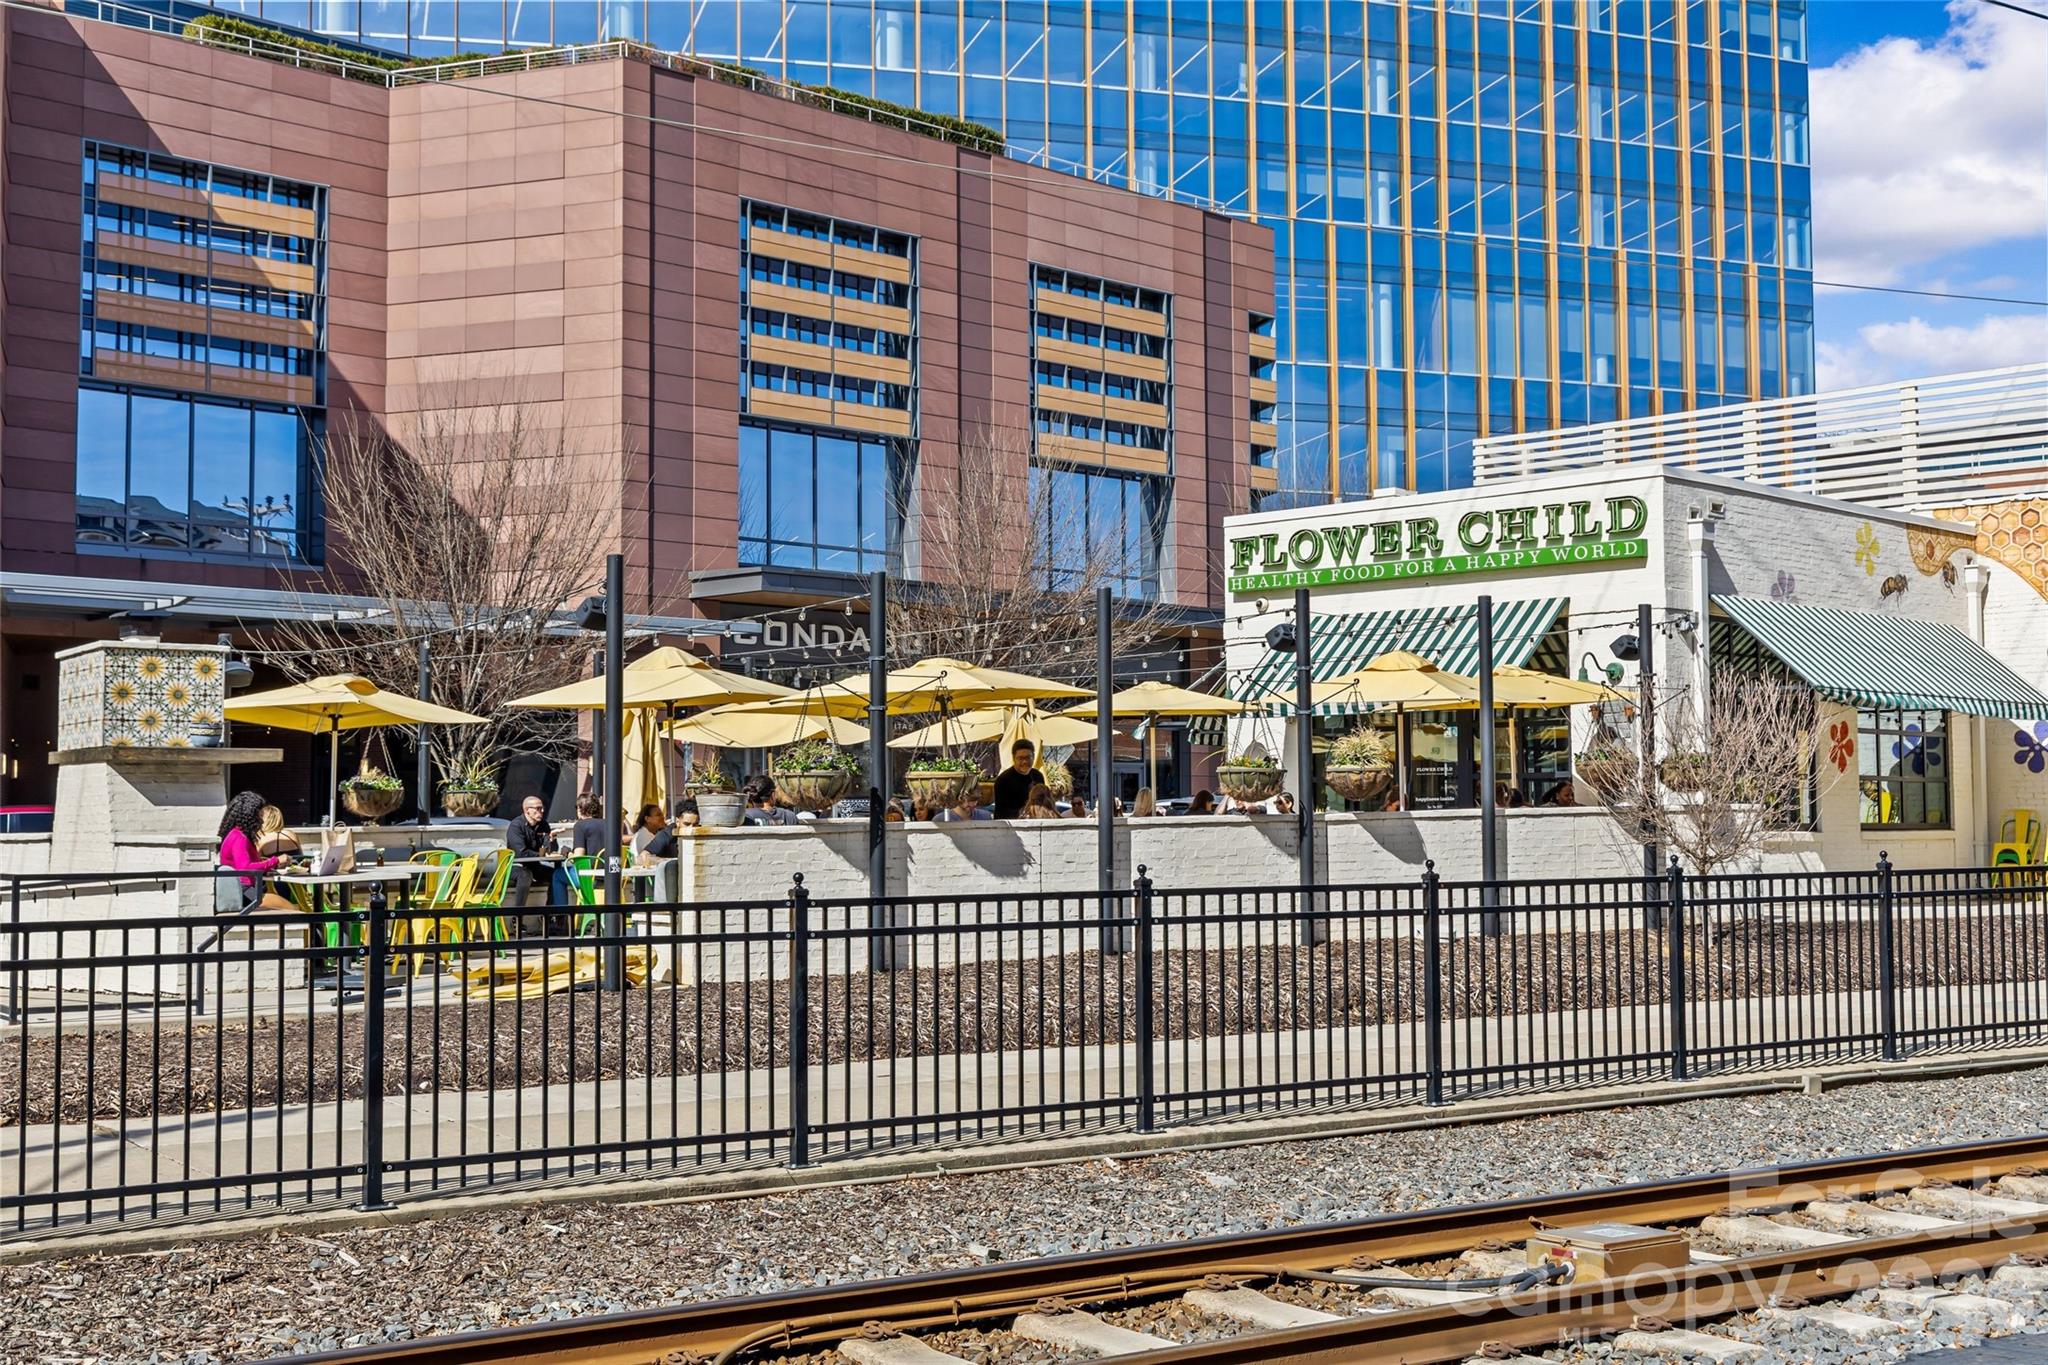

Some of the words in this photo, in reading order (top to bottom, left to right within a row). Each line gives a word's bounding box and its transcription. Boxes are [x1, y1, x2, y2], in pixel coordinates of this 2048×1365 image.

[1230, 517, 1444, 570] FLOWER
[1458, 495, 1648, 548] CHILD
[1231, 571, 1321, 591] HEALTHY
[1331, 564, 1385, 582] FOOD
[1394, 560, 1435, 576] FOR
[1443, 558, 1457, 571] A
[1466, 550, 1541, 570] HAPPY
[1551, 541, 1638, 561] WORLD
